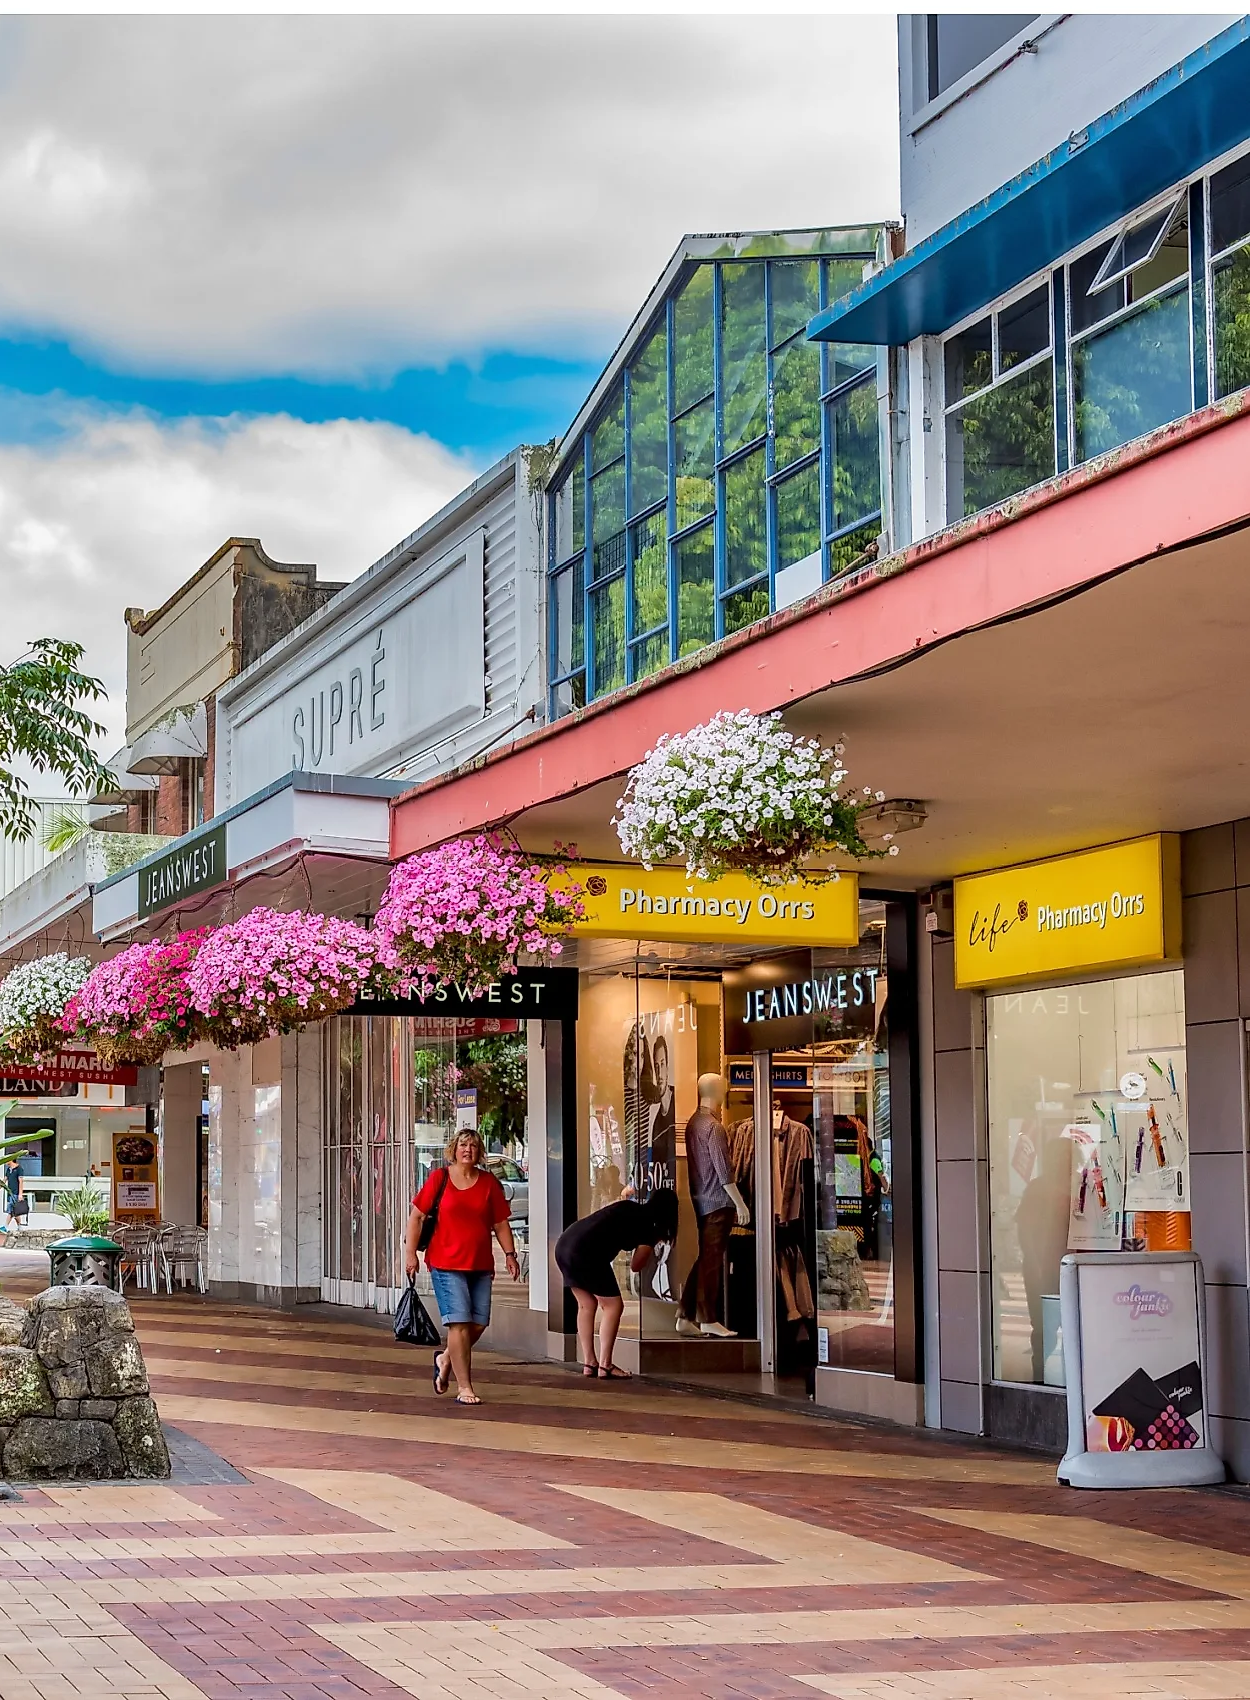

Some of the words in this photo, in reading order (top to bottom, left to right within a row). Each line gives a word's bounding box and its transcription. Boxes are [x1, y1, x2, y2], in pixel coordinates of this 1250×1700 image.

[145, 840, 216, 907] JEANSWEST
[619, 888, 751, 924] Pharmacy
[757, 894, 815, 920] Orrs
[969, 903, 1018, 952] life
[1038, 901, 1107, 932] Pharmacy
[1110, 891, 1144, 918] Orrs
[360, 981, 546, 1004] ENSWEST
[743, 968, 879, 1024] JEANSWEST
[3, 1067, 24, 1075] THE
[30, 1069, 72, 1078] FINEST
[79, 1072, 114, 1080] SUSHI
